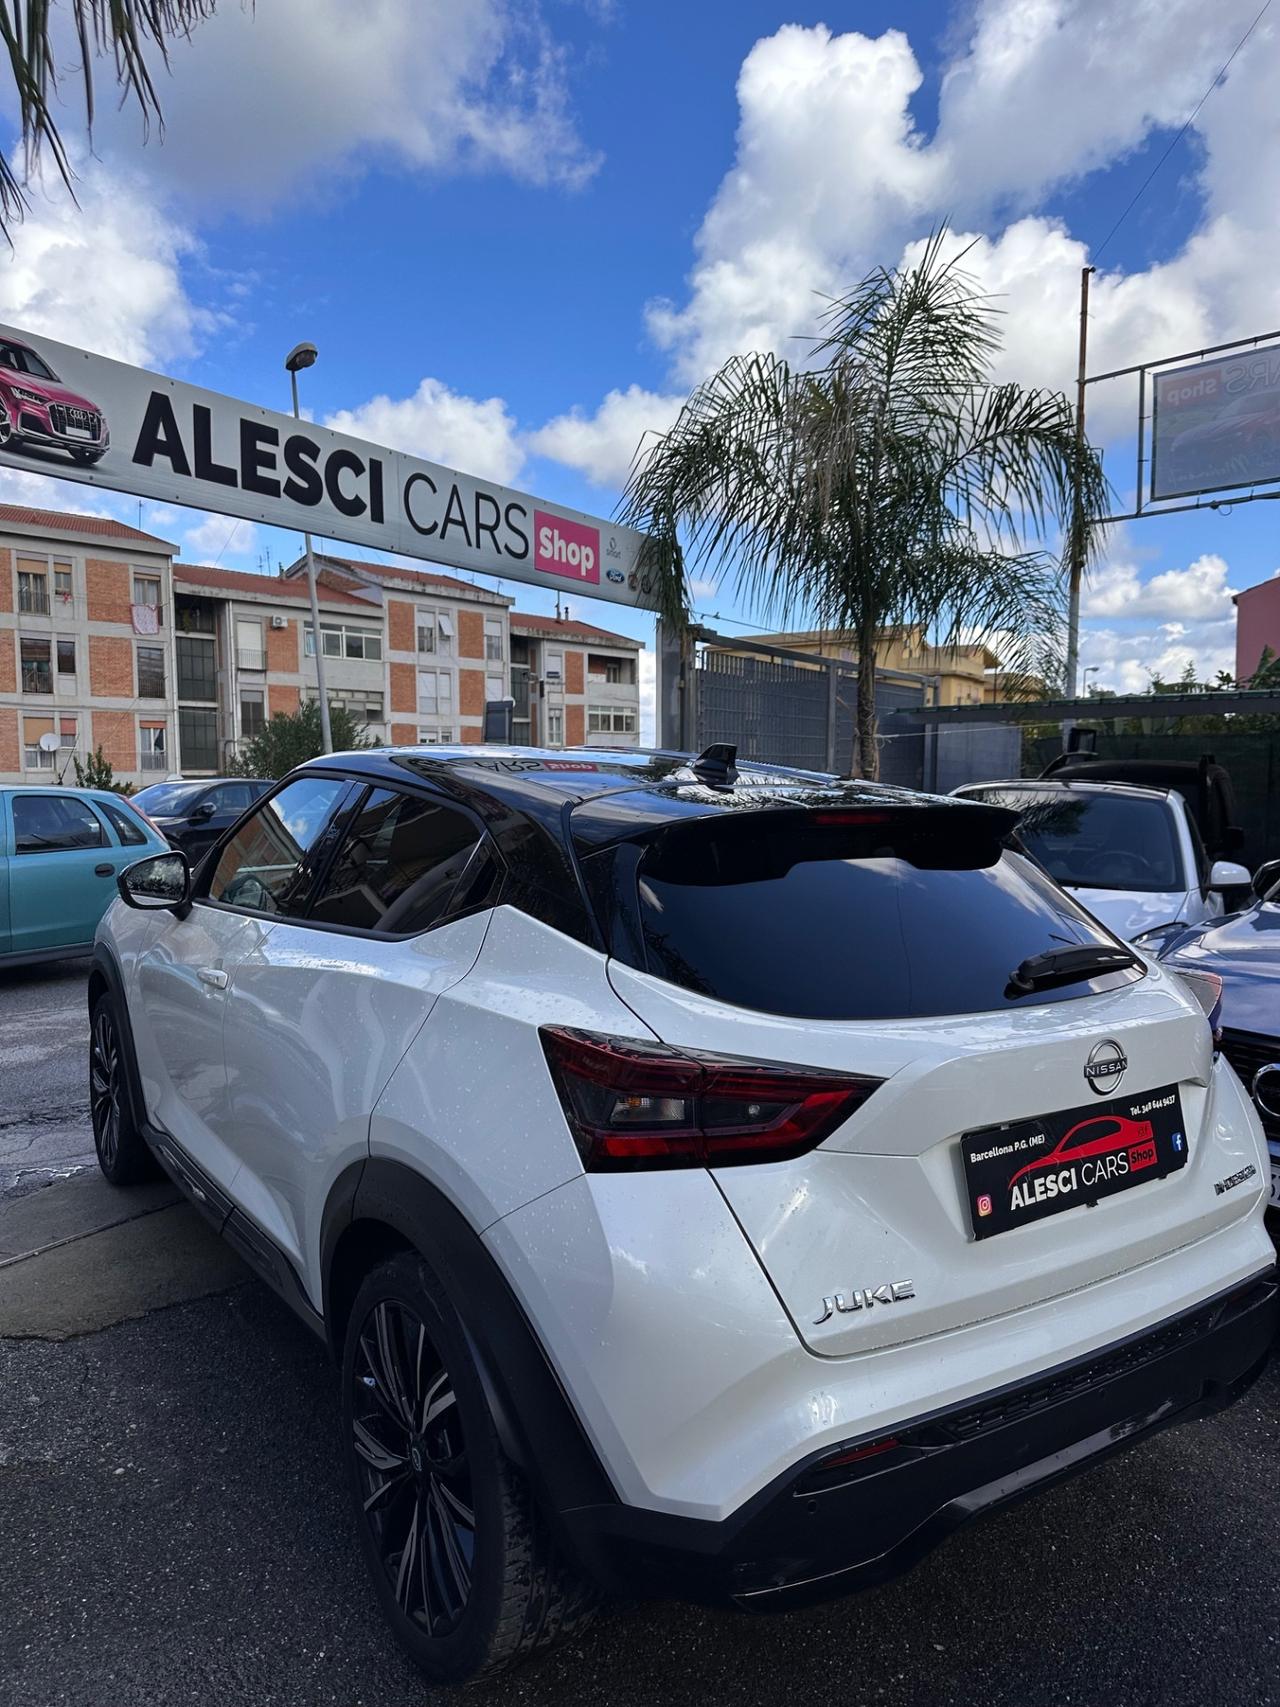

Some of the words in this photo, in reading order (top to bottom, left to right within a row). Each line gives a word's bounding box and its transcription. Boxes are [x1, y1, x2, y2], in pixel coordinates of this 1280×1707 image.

[132, 390, 384, 524] ALESCI
[403, 472, 530, 560] CARS
[539, 526, 595, 576] Shop
[1086, 1059, 1127, 1076] NISSAN
[1141, 1101, 1152, 1114] 348
[1152, 1099, 1163, 1109] 644
[1162, 1094, 1175, 1107] 9437
[970, 1145, 1013, 1163] Barcellona
[1014, 1140, 1028, 1151] P.G.
[1028, 1133, 1045, 1147] (ME)
[1011, 1166, 1077, 1211] ALESCI
[1081, 1152, 1129, 1185] CARS
[1130, 1148, 1153, 1164] Shop
[812, 1279, 916, 1325] JUKE
